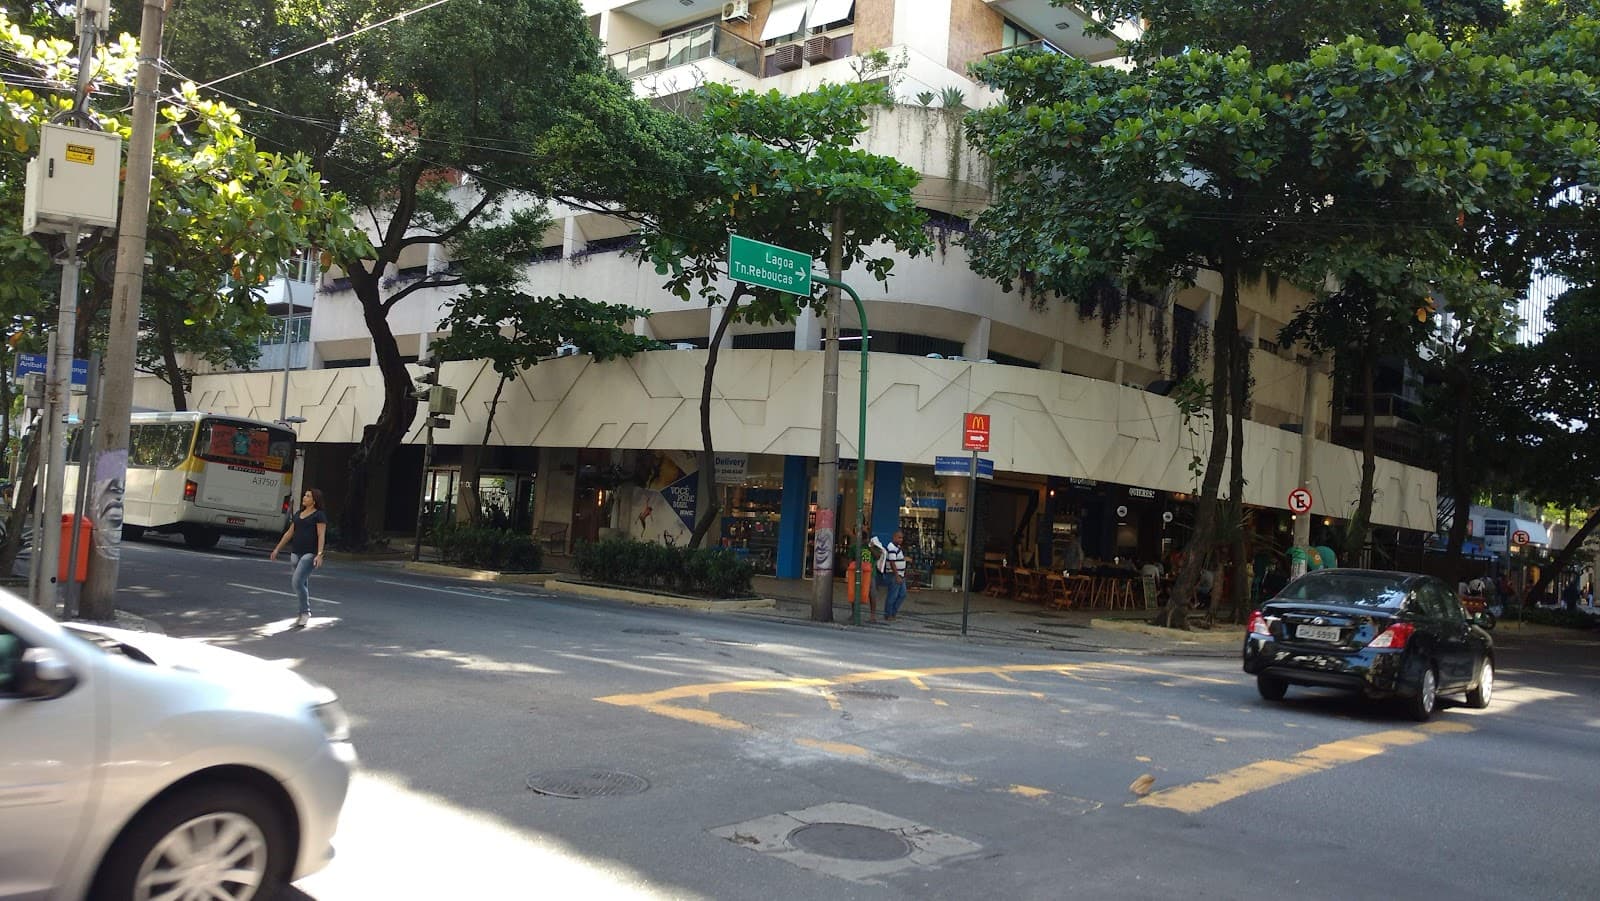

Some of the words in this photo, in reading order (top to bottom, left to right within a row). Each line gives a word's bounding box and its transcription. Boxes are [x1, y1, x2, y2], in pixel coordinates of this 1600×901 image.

[765, 252, 794, 270] Lagoa
[715, 456, 745, 467] Delivery
[252, 477, 279, 488] A37507
[670, 485, 690, 495] VOCÊ
[1296, 493, 1305, 509] E
